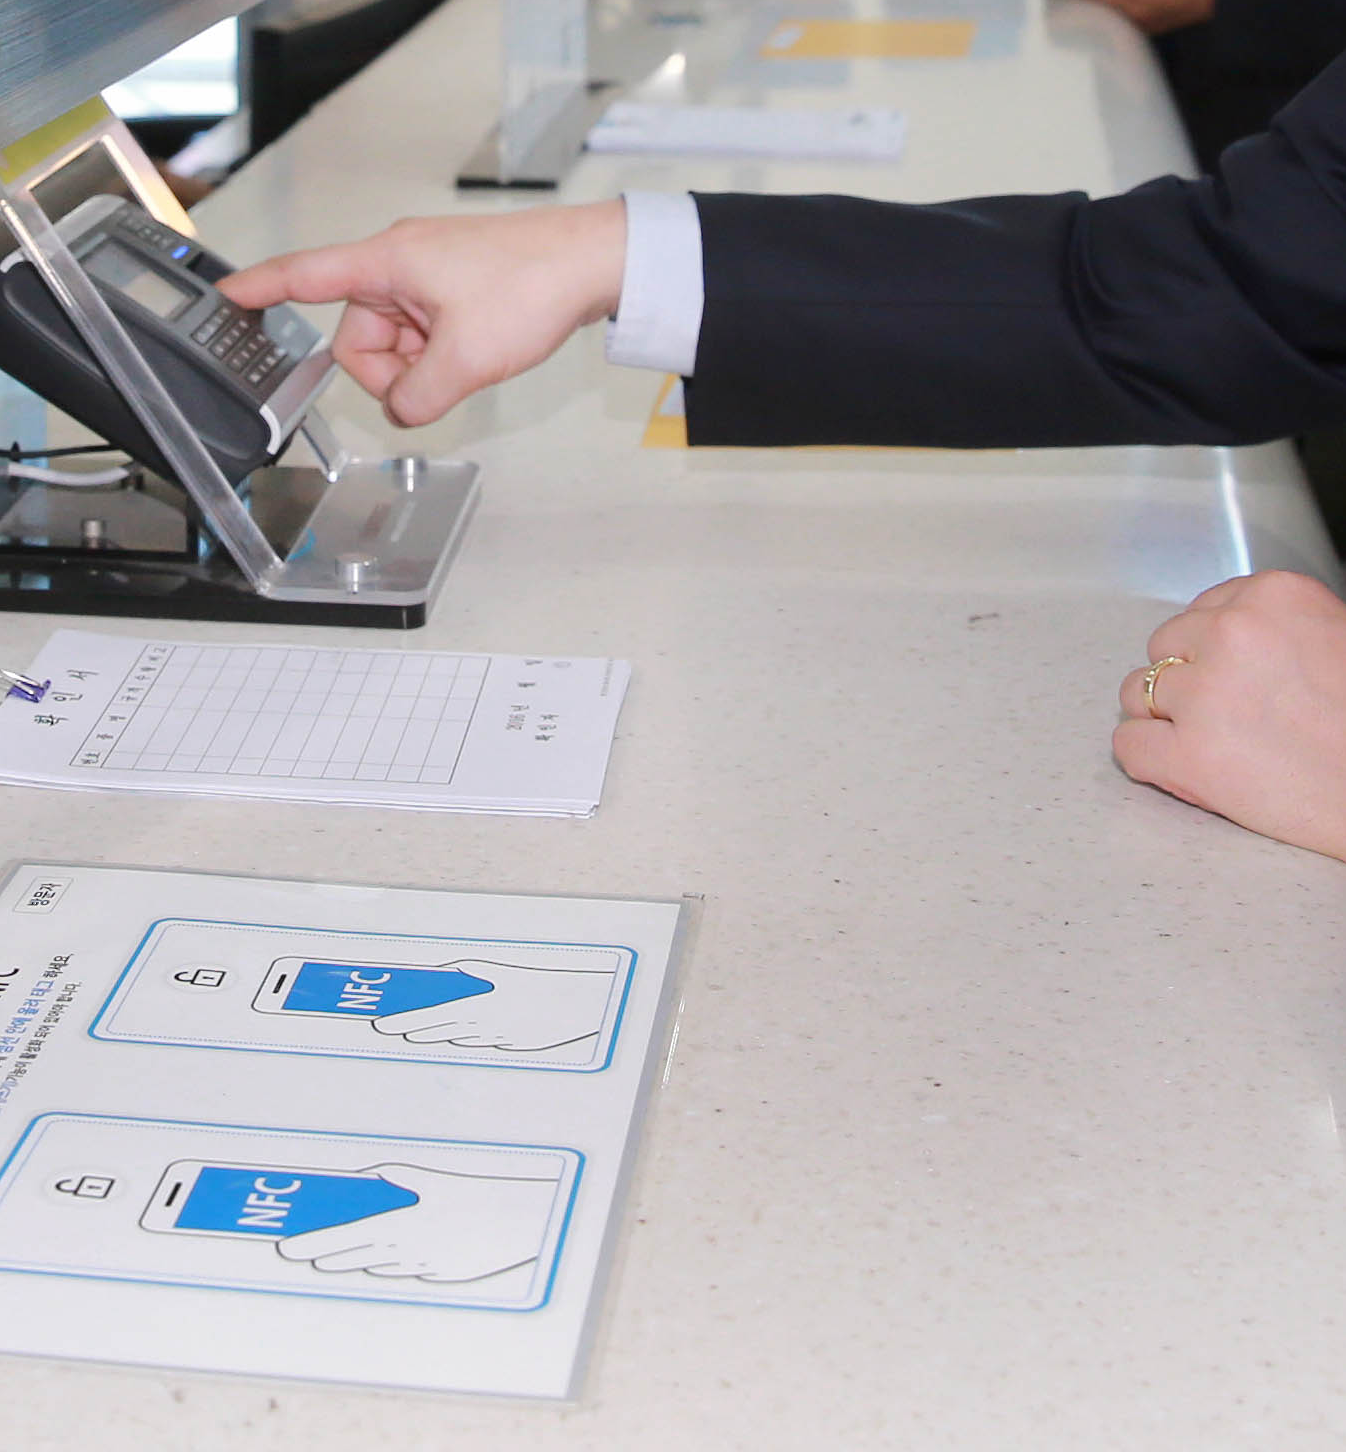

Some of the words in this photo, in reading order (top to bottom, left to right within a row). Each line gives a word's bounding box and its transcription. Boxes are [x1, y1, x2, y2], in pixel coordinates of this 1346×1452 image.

[27, 883, 63, 906] 방문자
[336, 970, 392, 1010] NFC
[236, 1177, 302, 1228] NFC
